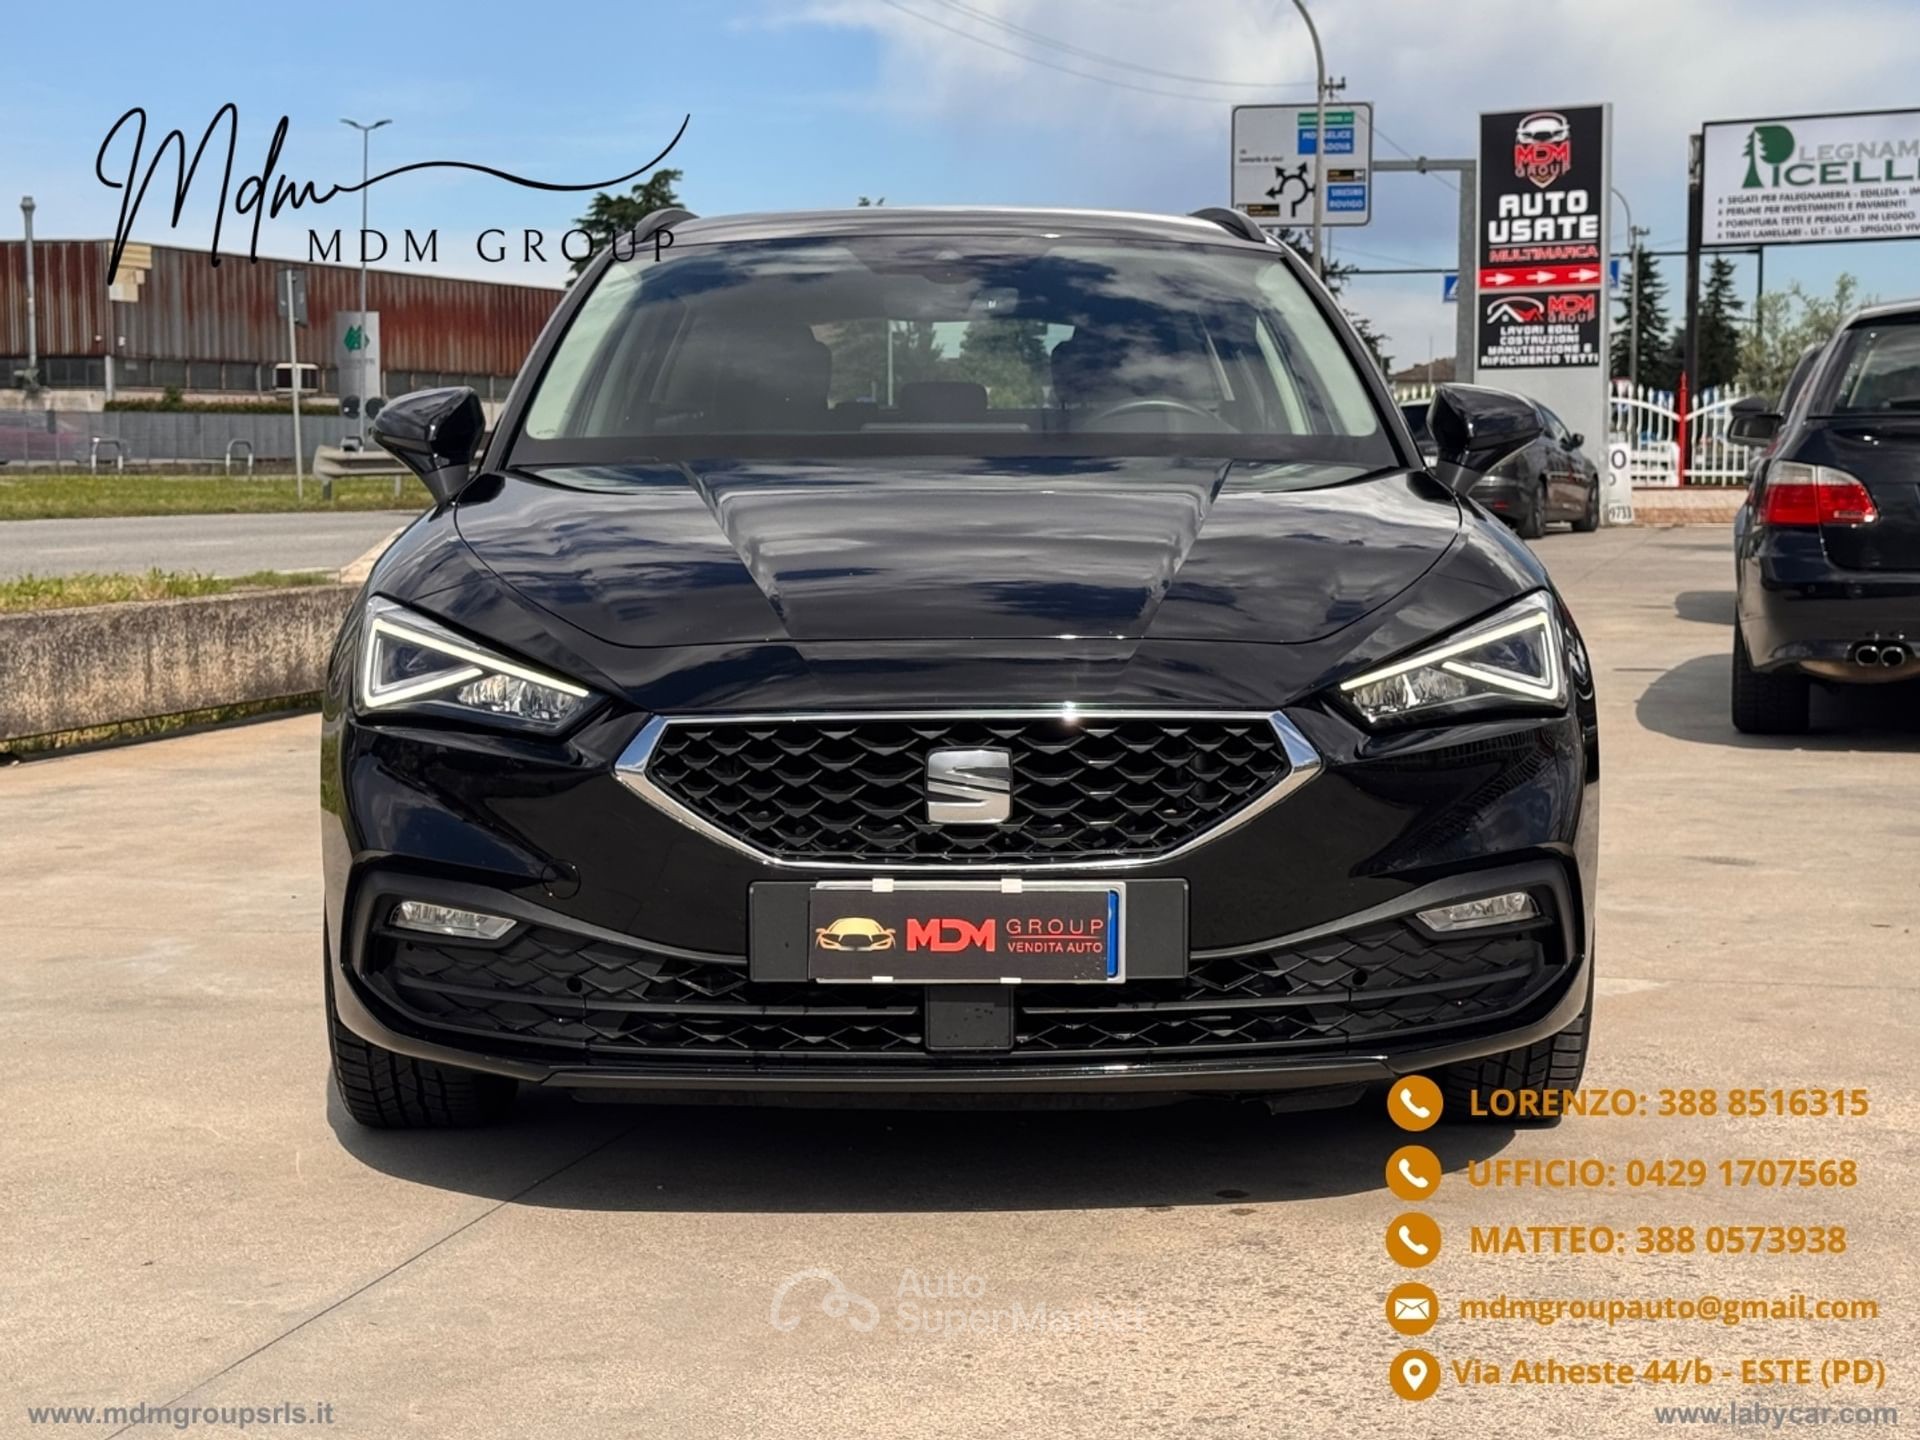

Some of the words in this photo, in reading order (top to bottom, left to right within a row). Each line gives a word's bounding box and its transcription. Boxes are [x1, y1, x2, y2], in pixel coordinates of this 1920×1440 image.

[1515, 139, 1571, 167] MDM
[1799, 139, 1920, 162] LEGNAM
[1515, 163, 1571, 178] GROUP
[1498, 189, 1589, 218] AUTO
[1761, 192, 1777, 203] PER
[1779, 189, 1850, 203] FALEGNAMERIA
[1725, 206, 1761, 217] PERLINE
[1764, 205, 1780, 215] PER
[1782, 201, 1845, 213] RIVESTIMENTI
[1856, 199, 1907, 209] PAVIMENTI
[1781, 215, 1804, 226] TETTI
[1814, 212, 1865, 224] PERGOLATI
[1868, 211, 1879, 221] IN
[1881, 210, 1916, 221] LEGNO
[1488, 215, 1599, 243] USATE
[1725, 230, 1750, 240] TRAVI
[1860, 222, 1902, 235] SPIGOLO
[1488, 245, 1599, 263] MULTIMARCA
[1548, 293, 1596, 314] MDM
[1500, 325, 1545, 336] LAVORI
[1547, 323, 1580, 335] EDILI
[1487, 344, 1581, 356] MANUTENZIONE
[1583, 342, 1593, 353] E
[1500, 334, 1580, 346] COSTRUZIONI
[1481, 354, 1561, 366] RIFACIMENTO
[1564, 353, 1599, 364] TETTI
[905, 917, 997, 953] MDM
[1005, 918, 1105, 935] GROUP
[1007, 942, 1064, 953] VENDITA
[1067, 942, 1104, 954] AUTO
